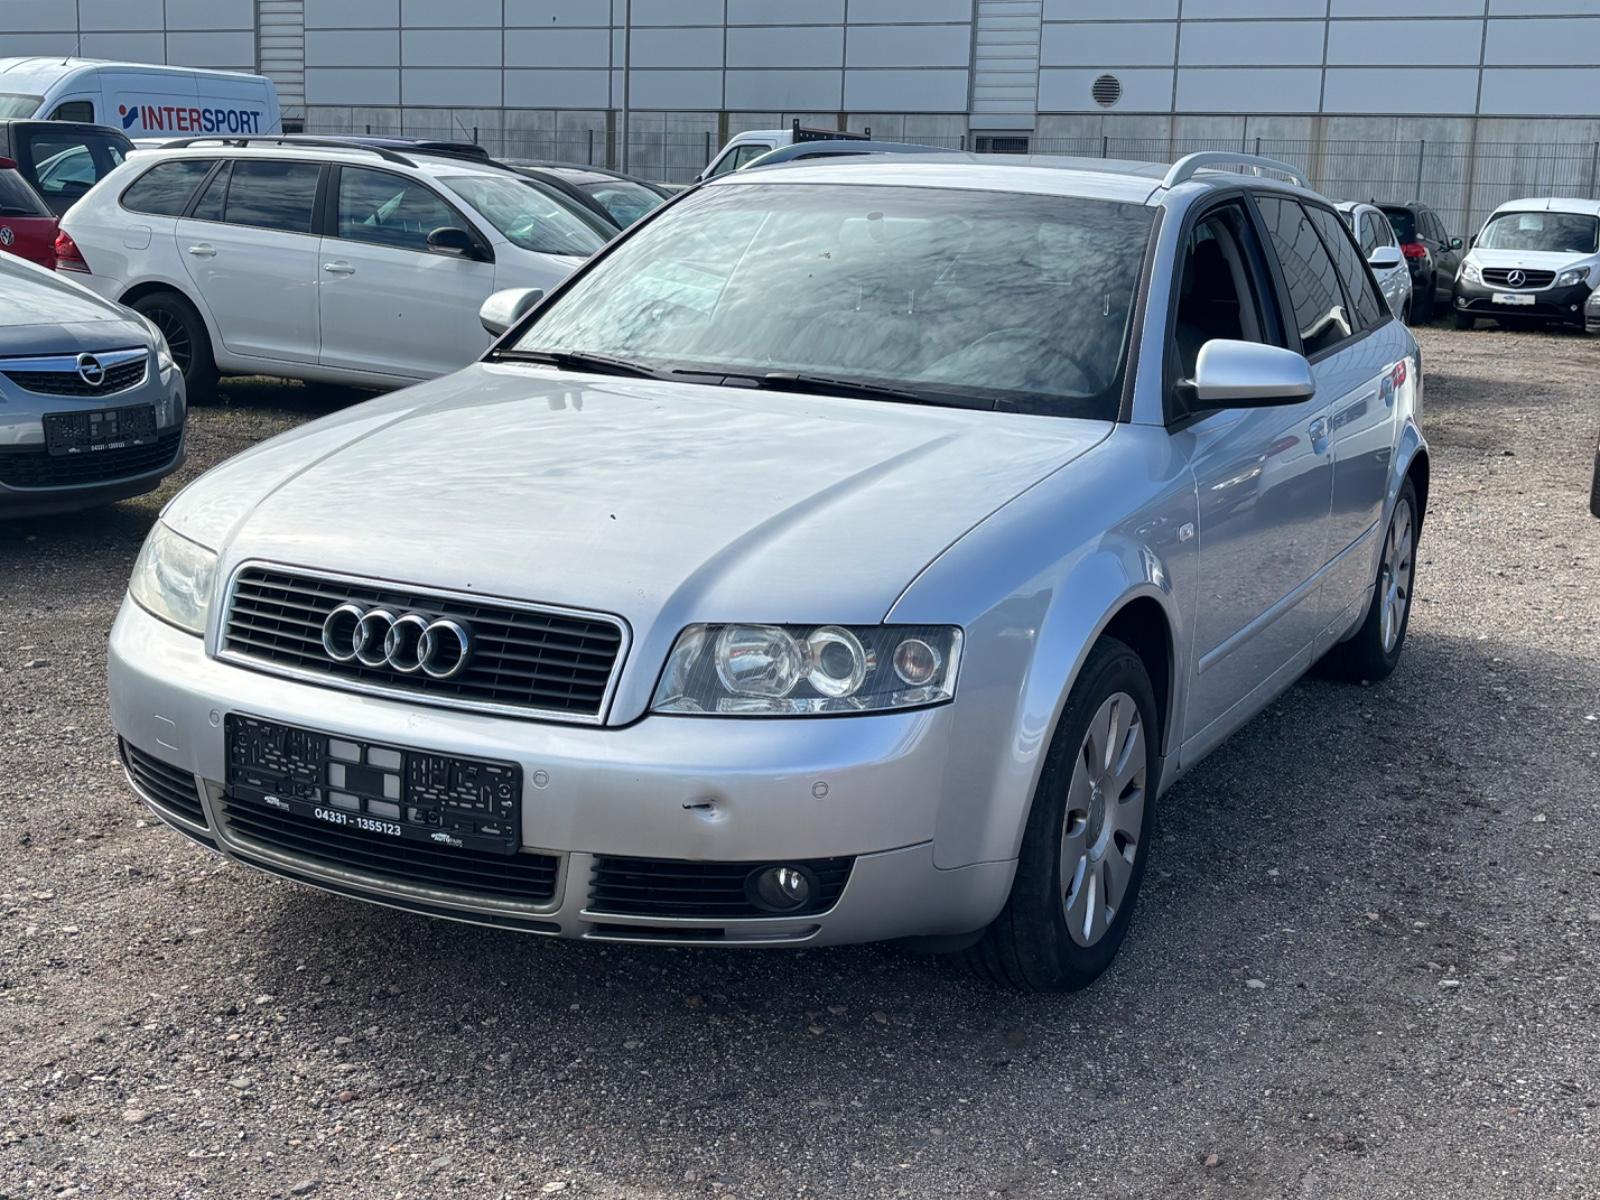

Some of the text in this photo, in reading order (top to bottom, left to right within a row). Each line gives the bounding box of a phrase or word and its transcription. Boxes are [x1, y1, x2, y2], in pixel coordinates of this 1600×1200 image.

[140, 104, 261, 134] INTERSPORT
[314, 808, 347, 825] 04331
[357, 817, 401, 836] 1355123
